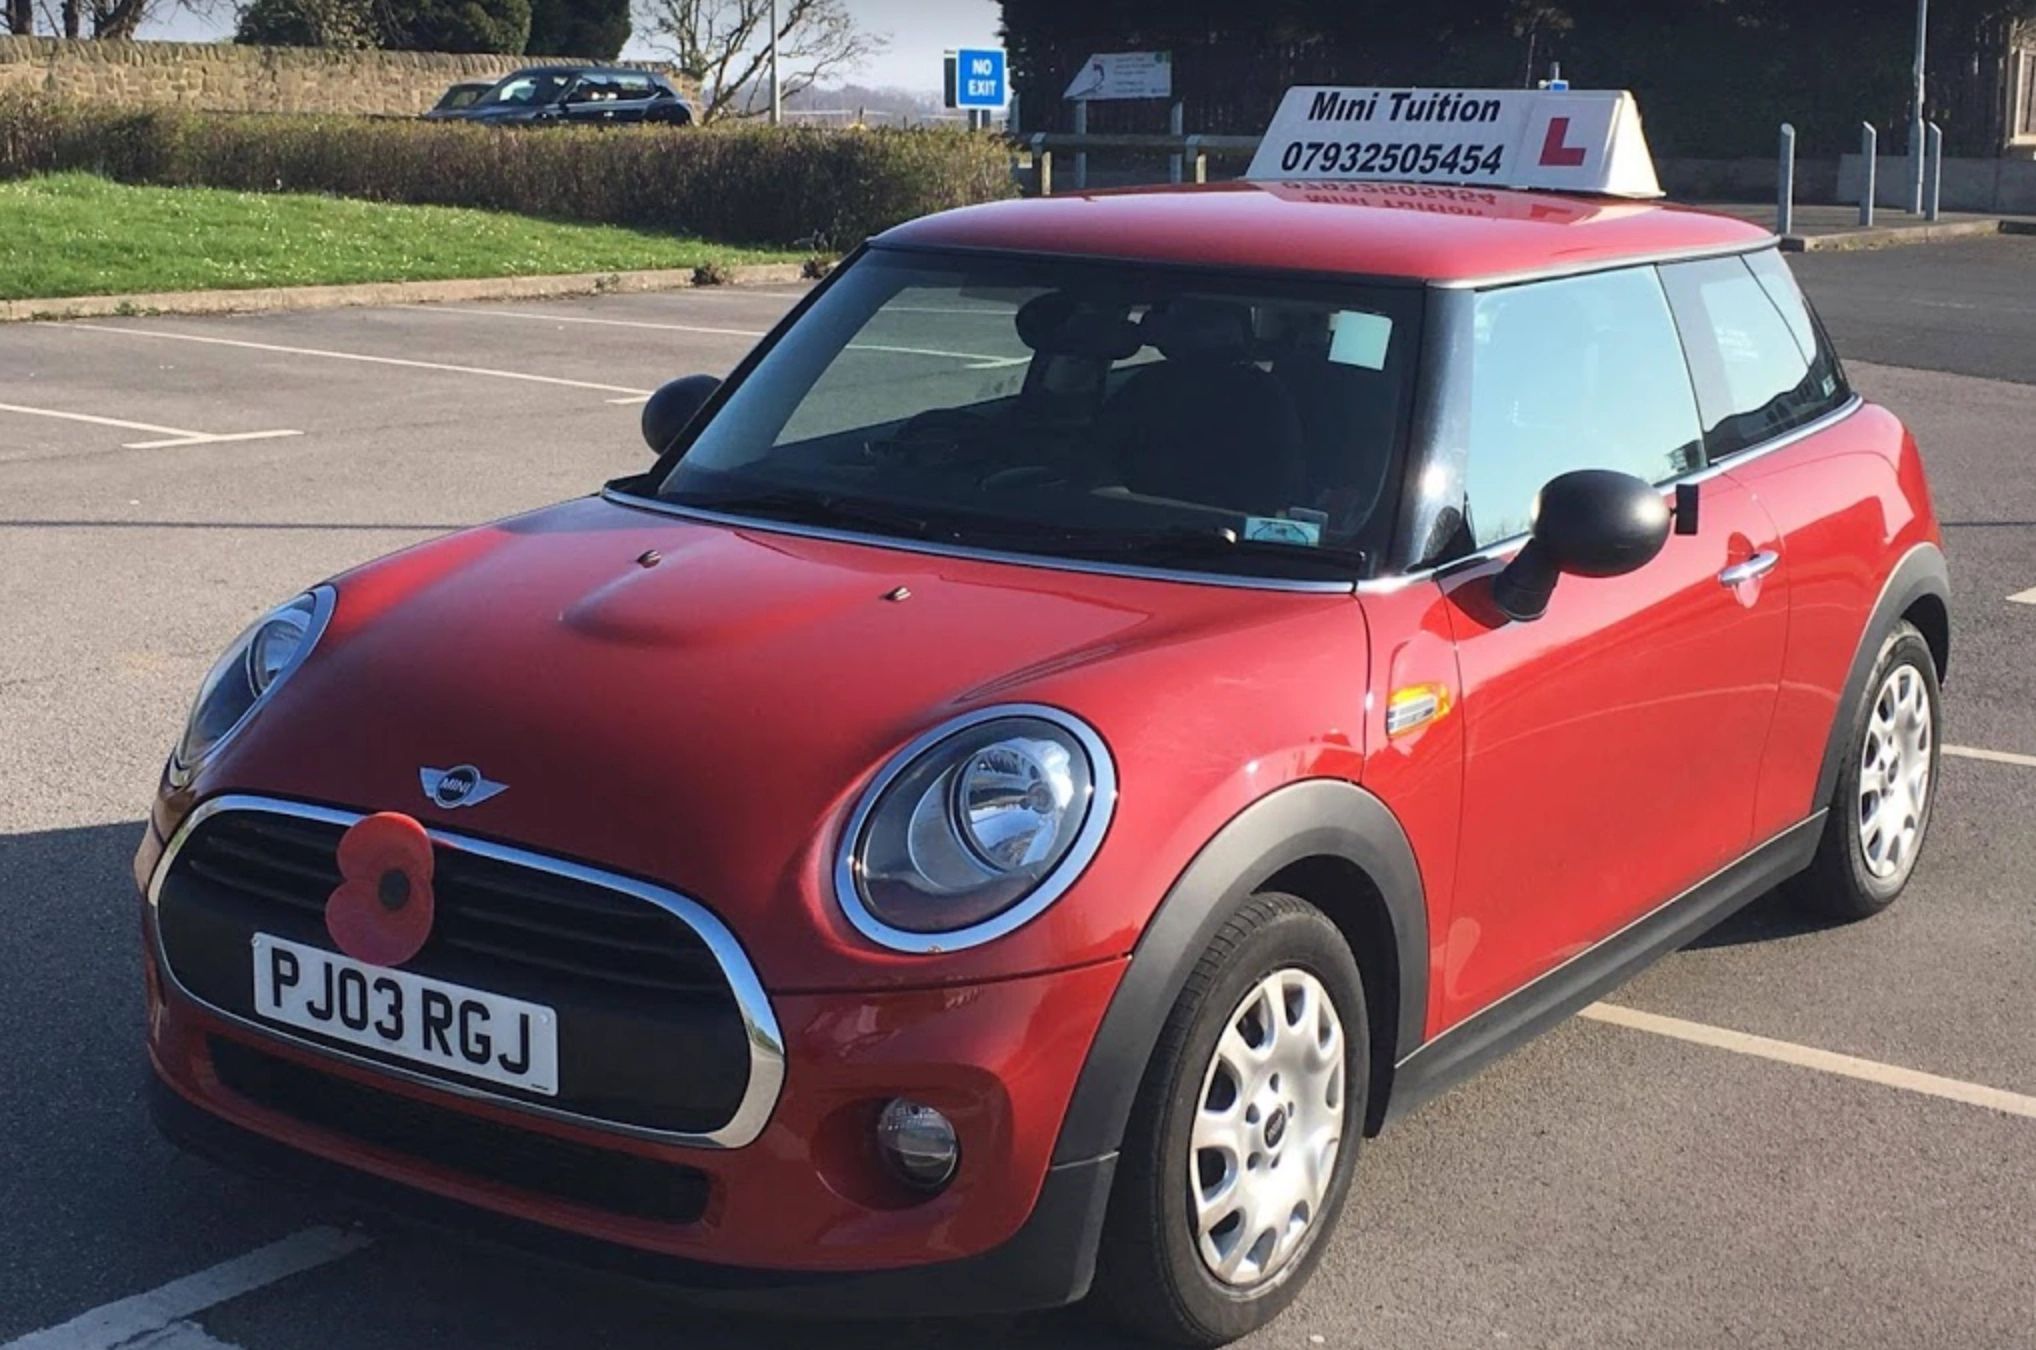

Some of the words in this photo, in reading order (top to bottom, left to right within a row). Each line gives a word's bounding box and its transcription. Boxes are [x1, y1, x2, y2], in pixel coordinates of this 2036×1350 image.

[972, 58, 993, 75] NO
[968, 79, 997, 97] EXIT
[1307, 91, 1379, 122] Mini
[1388, 92, 1501, 122] Tuition
[1538, 116, 1587, 168] L
[1280, 141, 1505, 175] 07932505454
[440, 778, 471, 793] MINI
[271, 947, 404, 1041] PJ03
[421, 988, 531, 1075] RGJ
